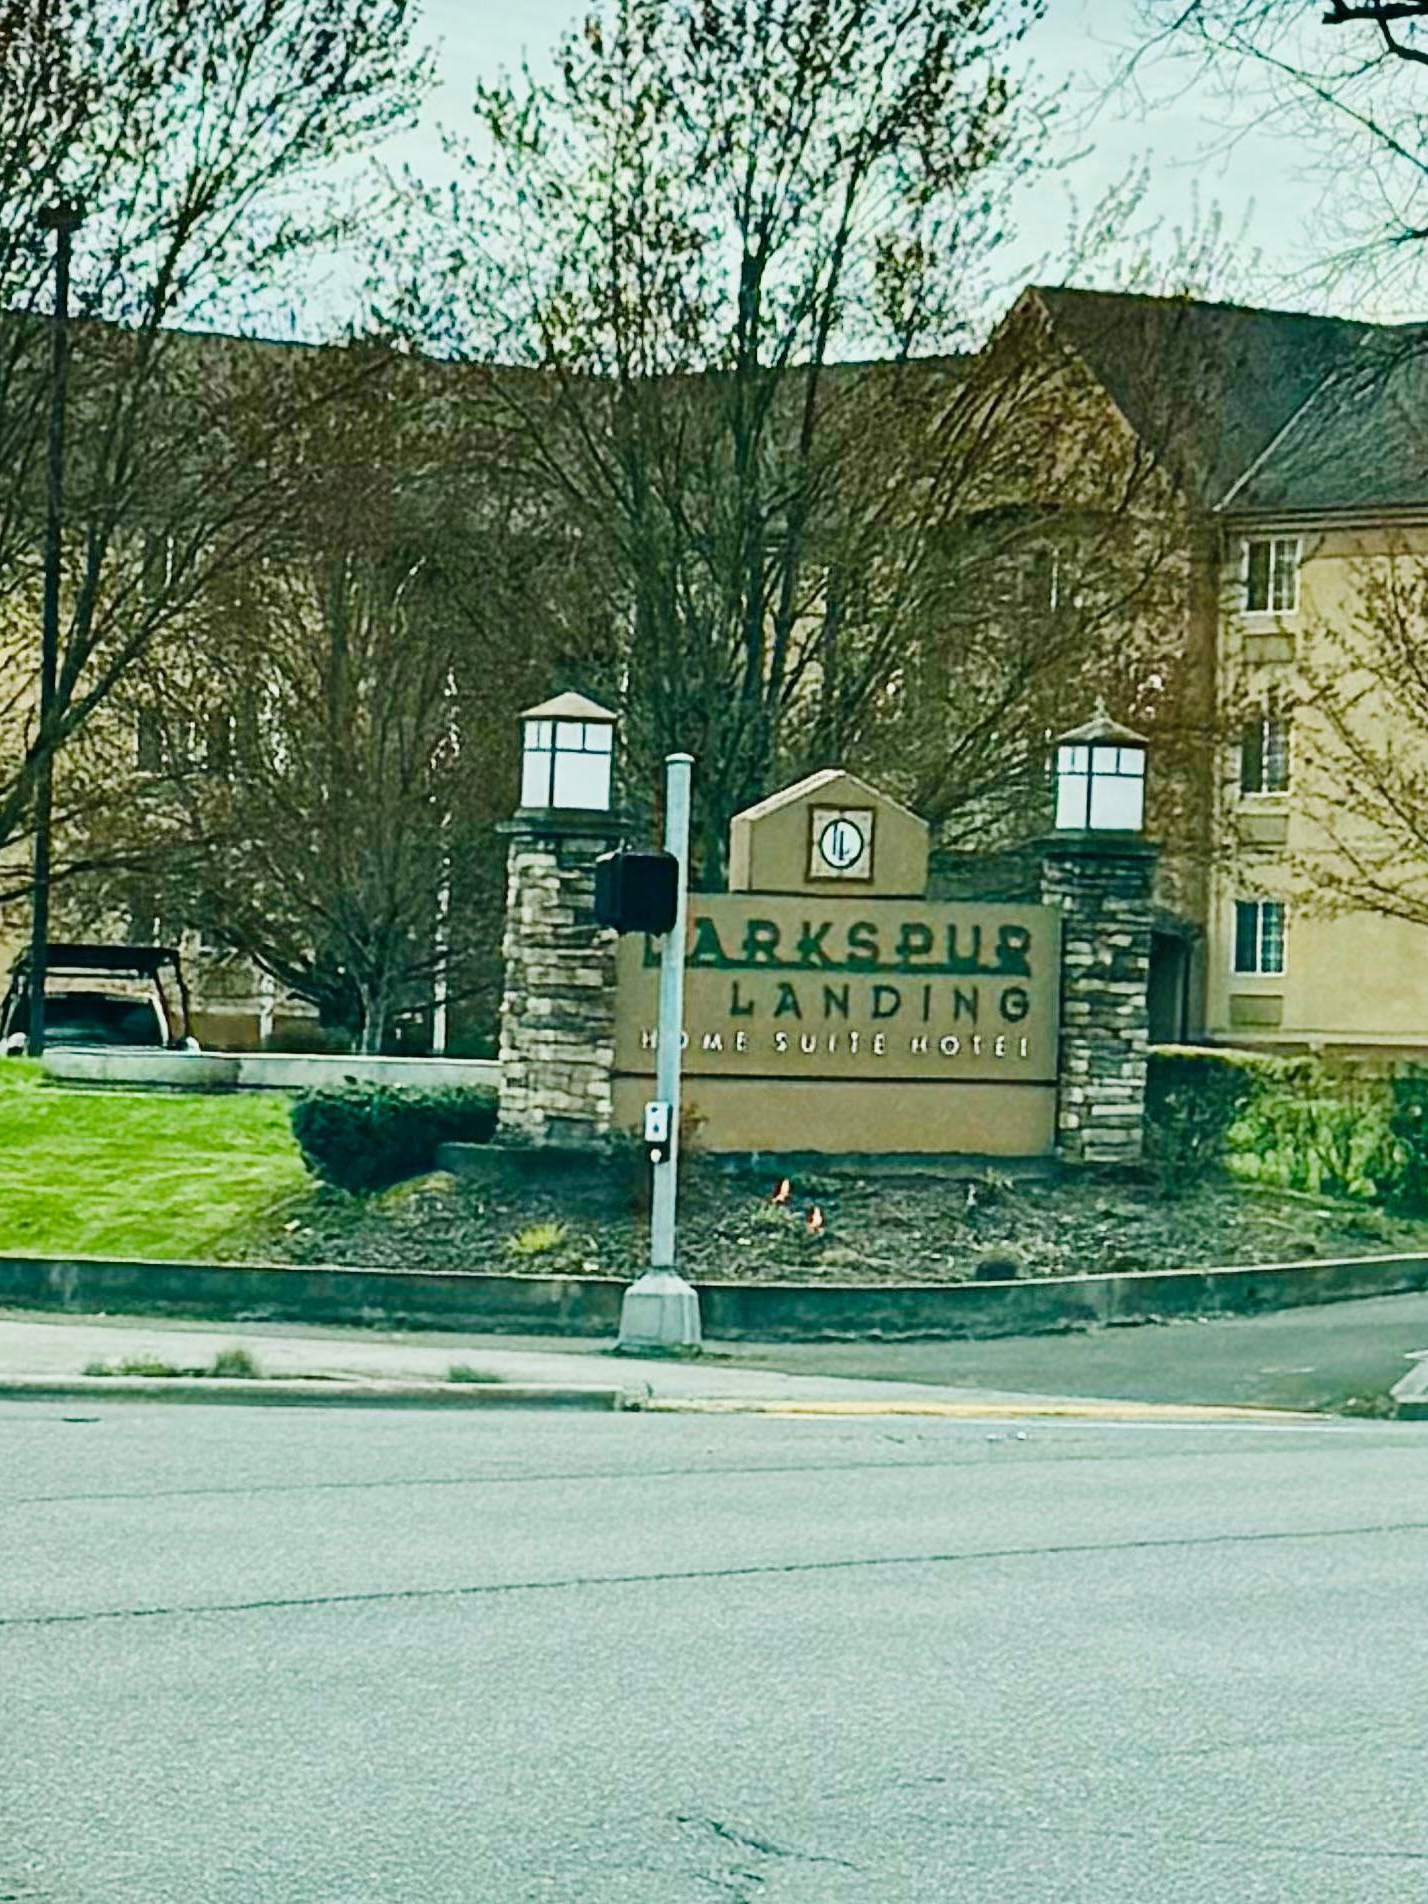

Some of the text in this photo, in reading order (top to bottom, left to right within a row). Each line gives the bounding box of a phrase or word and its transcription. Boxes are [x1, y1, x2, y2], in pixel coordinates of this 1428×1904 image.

[729, 979, 1030, 1024] LANDING
[774, 1031, 887, 1056] SUITE
[910, 1034, 1029, 1058] HOTEL
